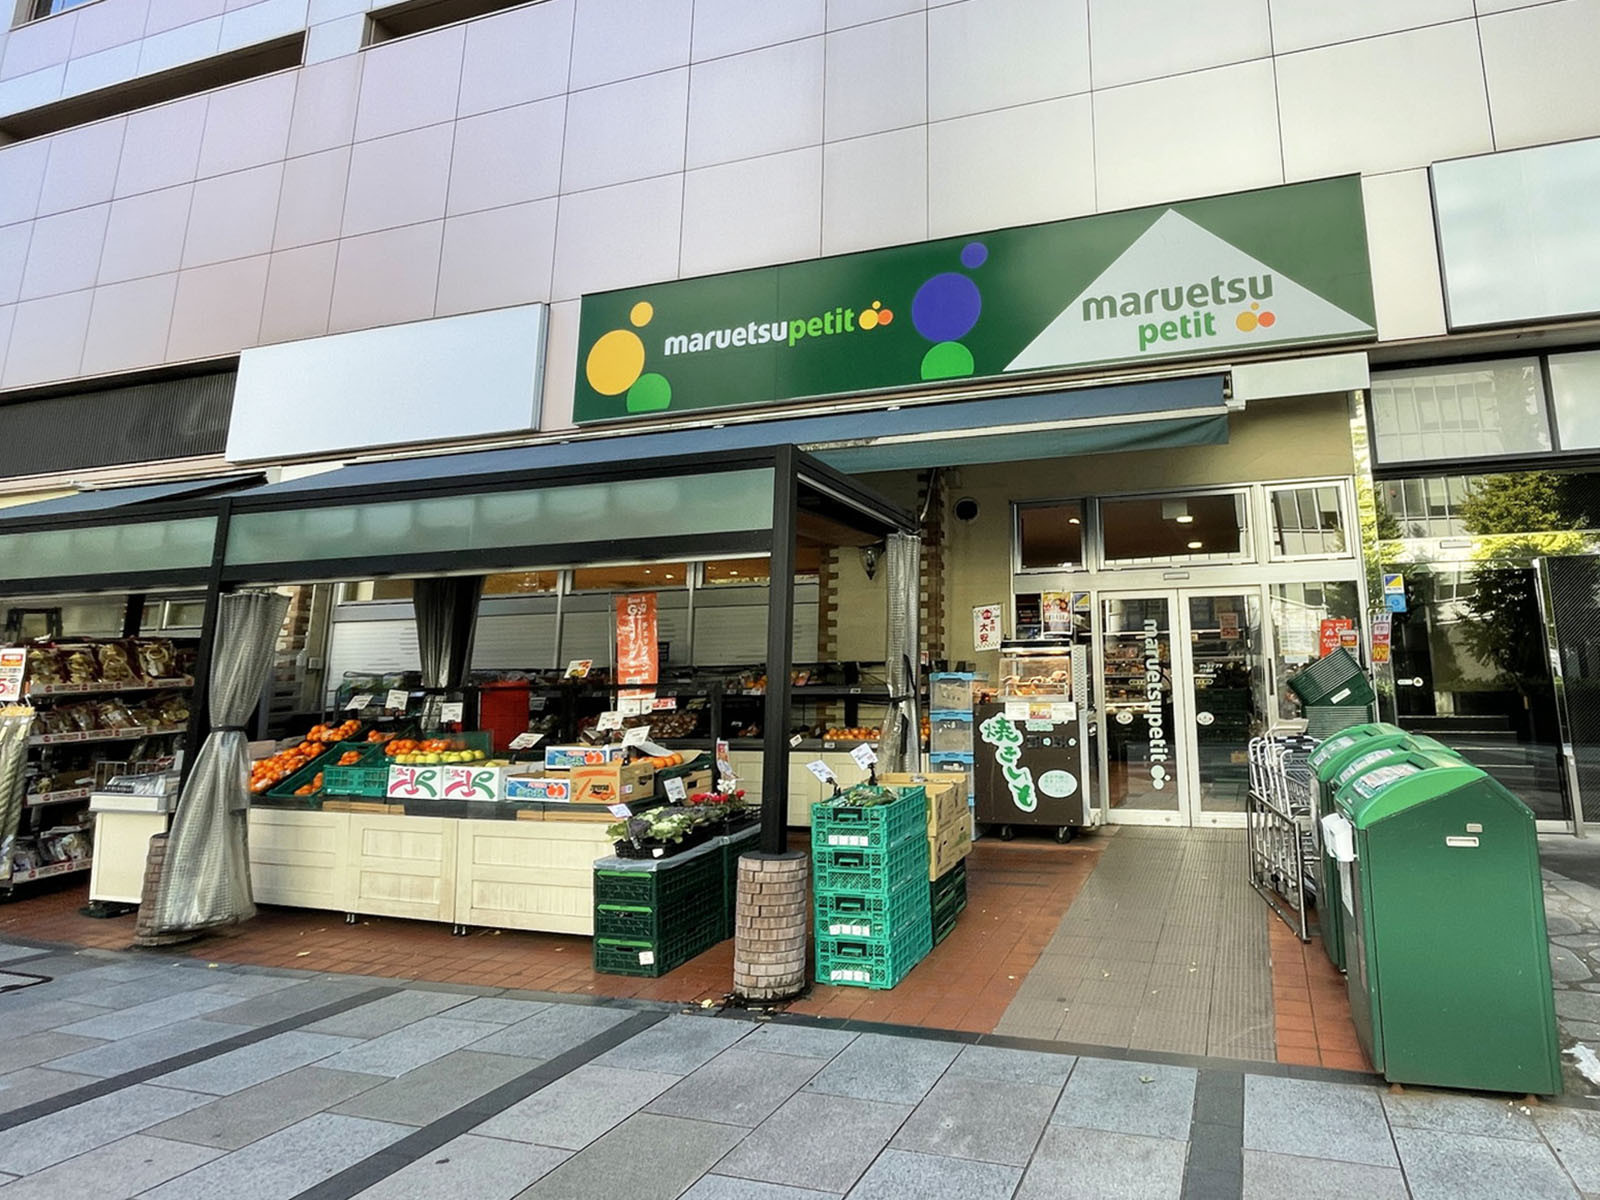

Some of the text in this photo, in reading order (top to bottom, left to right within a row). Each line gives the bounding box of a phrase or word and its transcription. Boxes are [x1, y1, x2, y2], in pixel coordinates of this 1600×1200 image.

[1083, 274, 1273, 321] maruetsu
[664, 307, 855, 356] maruetsupetit
[1138, 311, 1216, 352] petit
[1143, 619, 1169, 763] maruetsupetit
